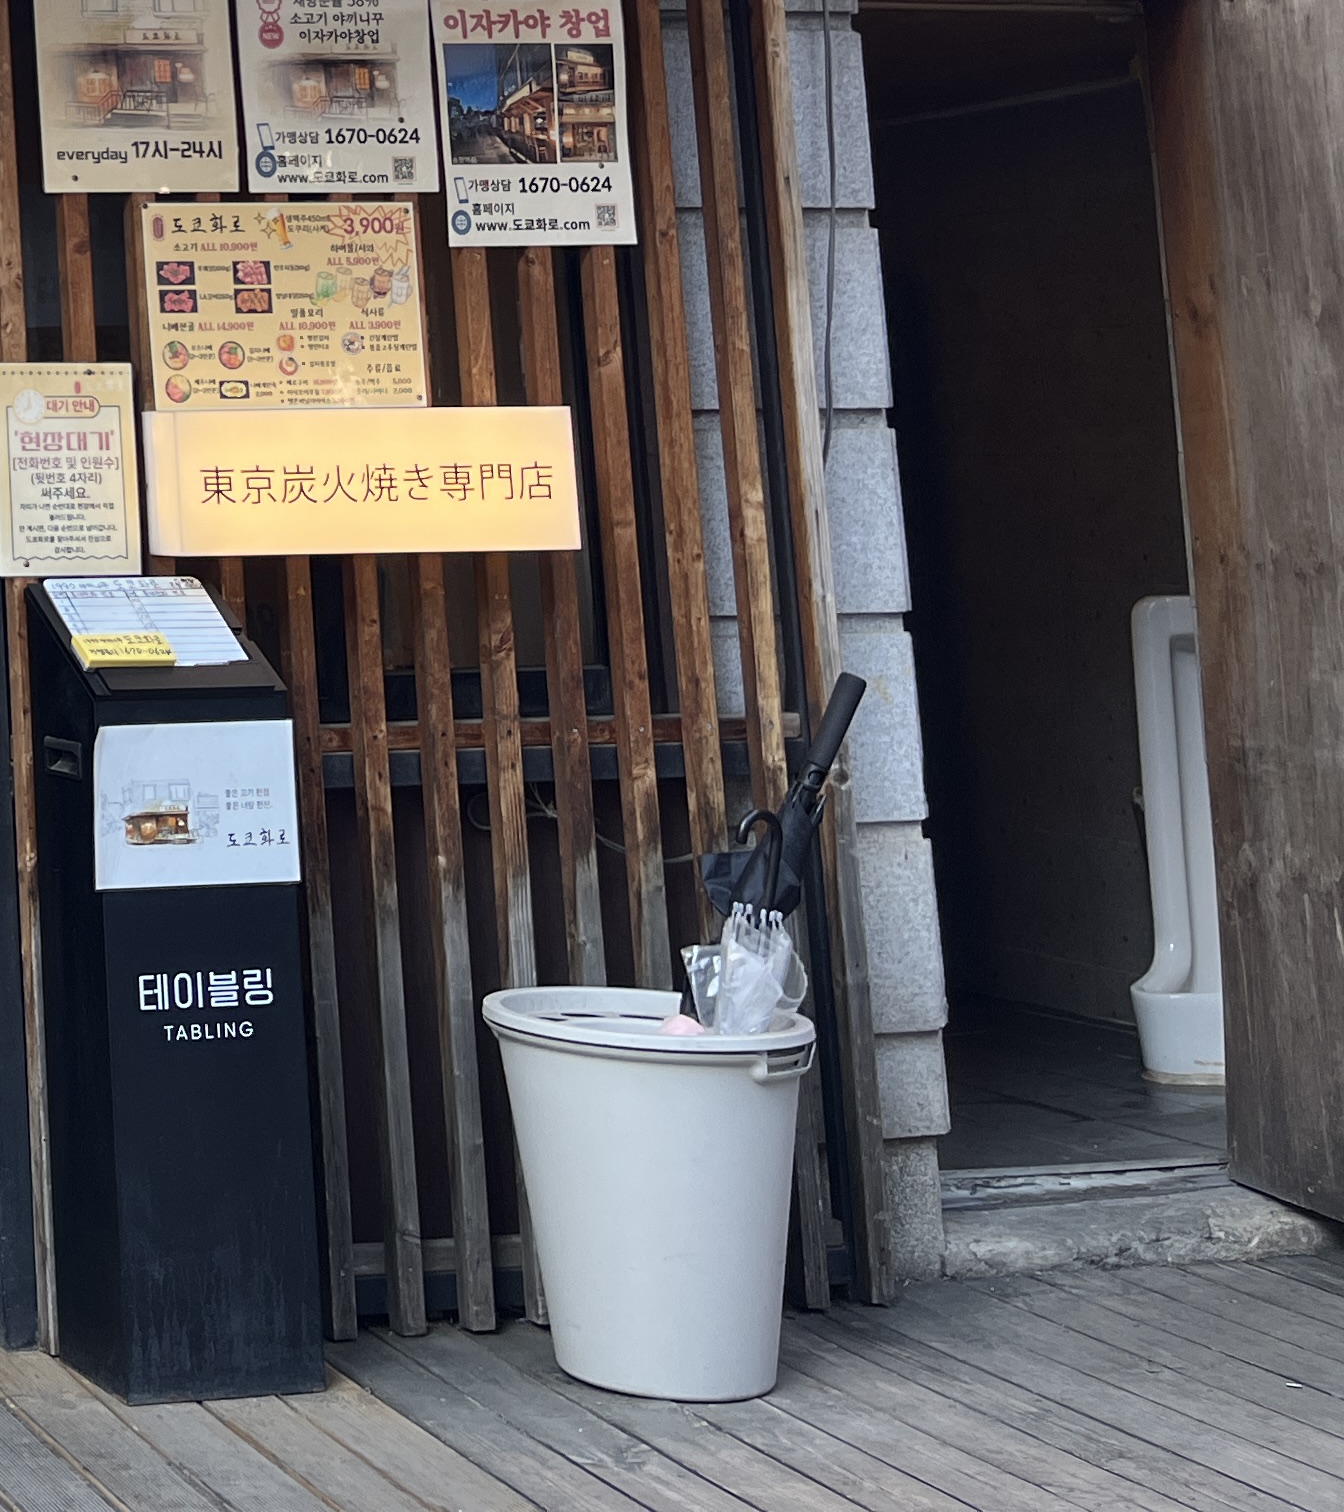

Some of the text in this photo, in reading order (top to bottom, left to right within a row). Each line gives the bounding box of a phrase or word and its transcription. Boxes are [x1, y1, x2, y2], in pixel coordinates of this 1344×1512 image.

[289, 12, 384, 26] 소고기 야끼니꾸
[443, 8, 611, 39] 이자카야 창업
[298, 29, 379, 44] 이자카야창업
[275, 128, 421, 144] 가맹상담 1670-0624
[57, 140, 223, 164] everyday 17시-24시
[468, 176, 612, 193] 가맹상담 1670-0624
[472, 203, 515, 215] 홈페이지
[343, 217, 404, 236] 3,900원
[475, 218, 591, 231] www.도쿄화로.com
[173, 243, 198, 252] 소고기
[201, 243, 217, 251] ALL
[327, 257, 343, 266] ALL
[198, 322, 215, 331] ALL
[279, 322, 296, 330] ALL
[349, 321, 365, 329] ALL
[47, 399, 95, 413] 대기 안내
[66, 458, 77, 469] 및
[70, 473, 102, 485] 4자리)
[199, 460, 553, 505] 東京炭火焼き専門店
[138, 968, 274, 1012] 테이블링
[164, 1021, 254, 1042] TABLING
